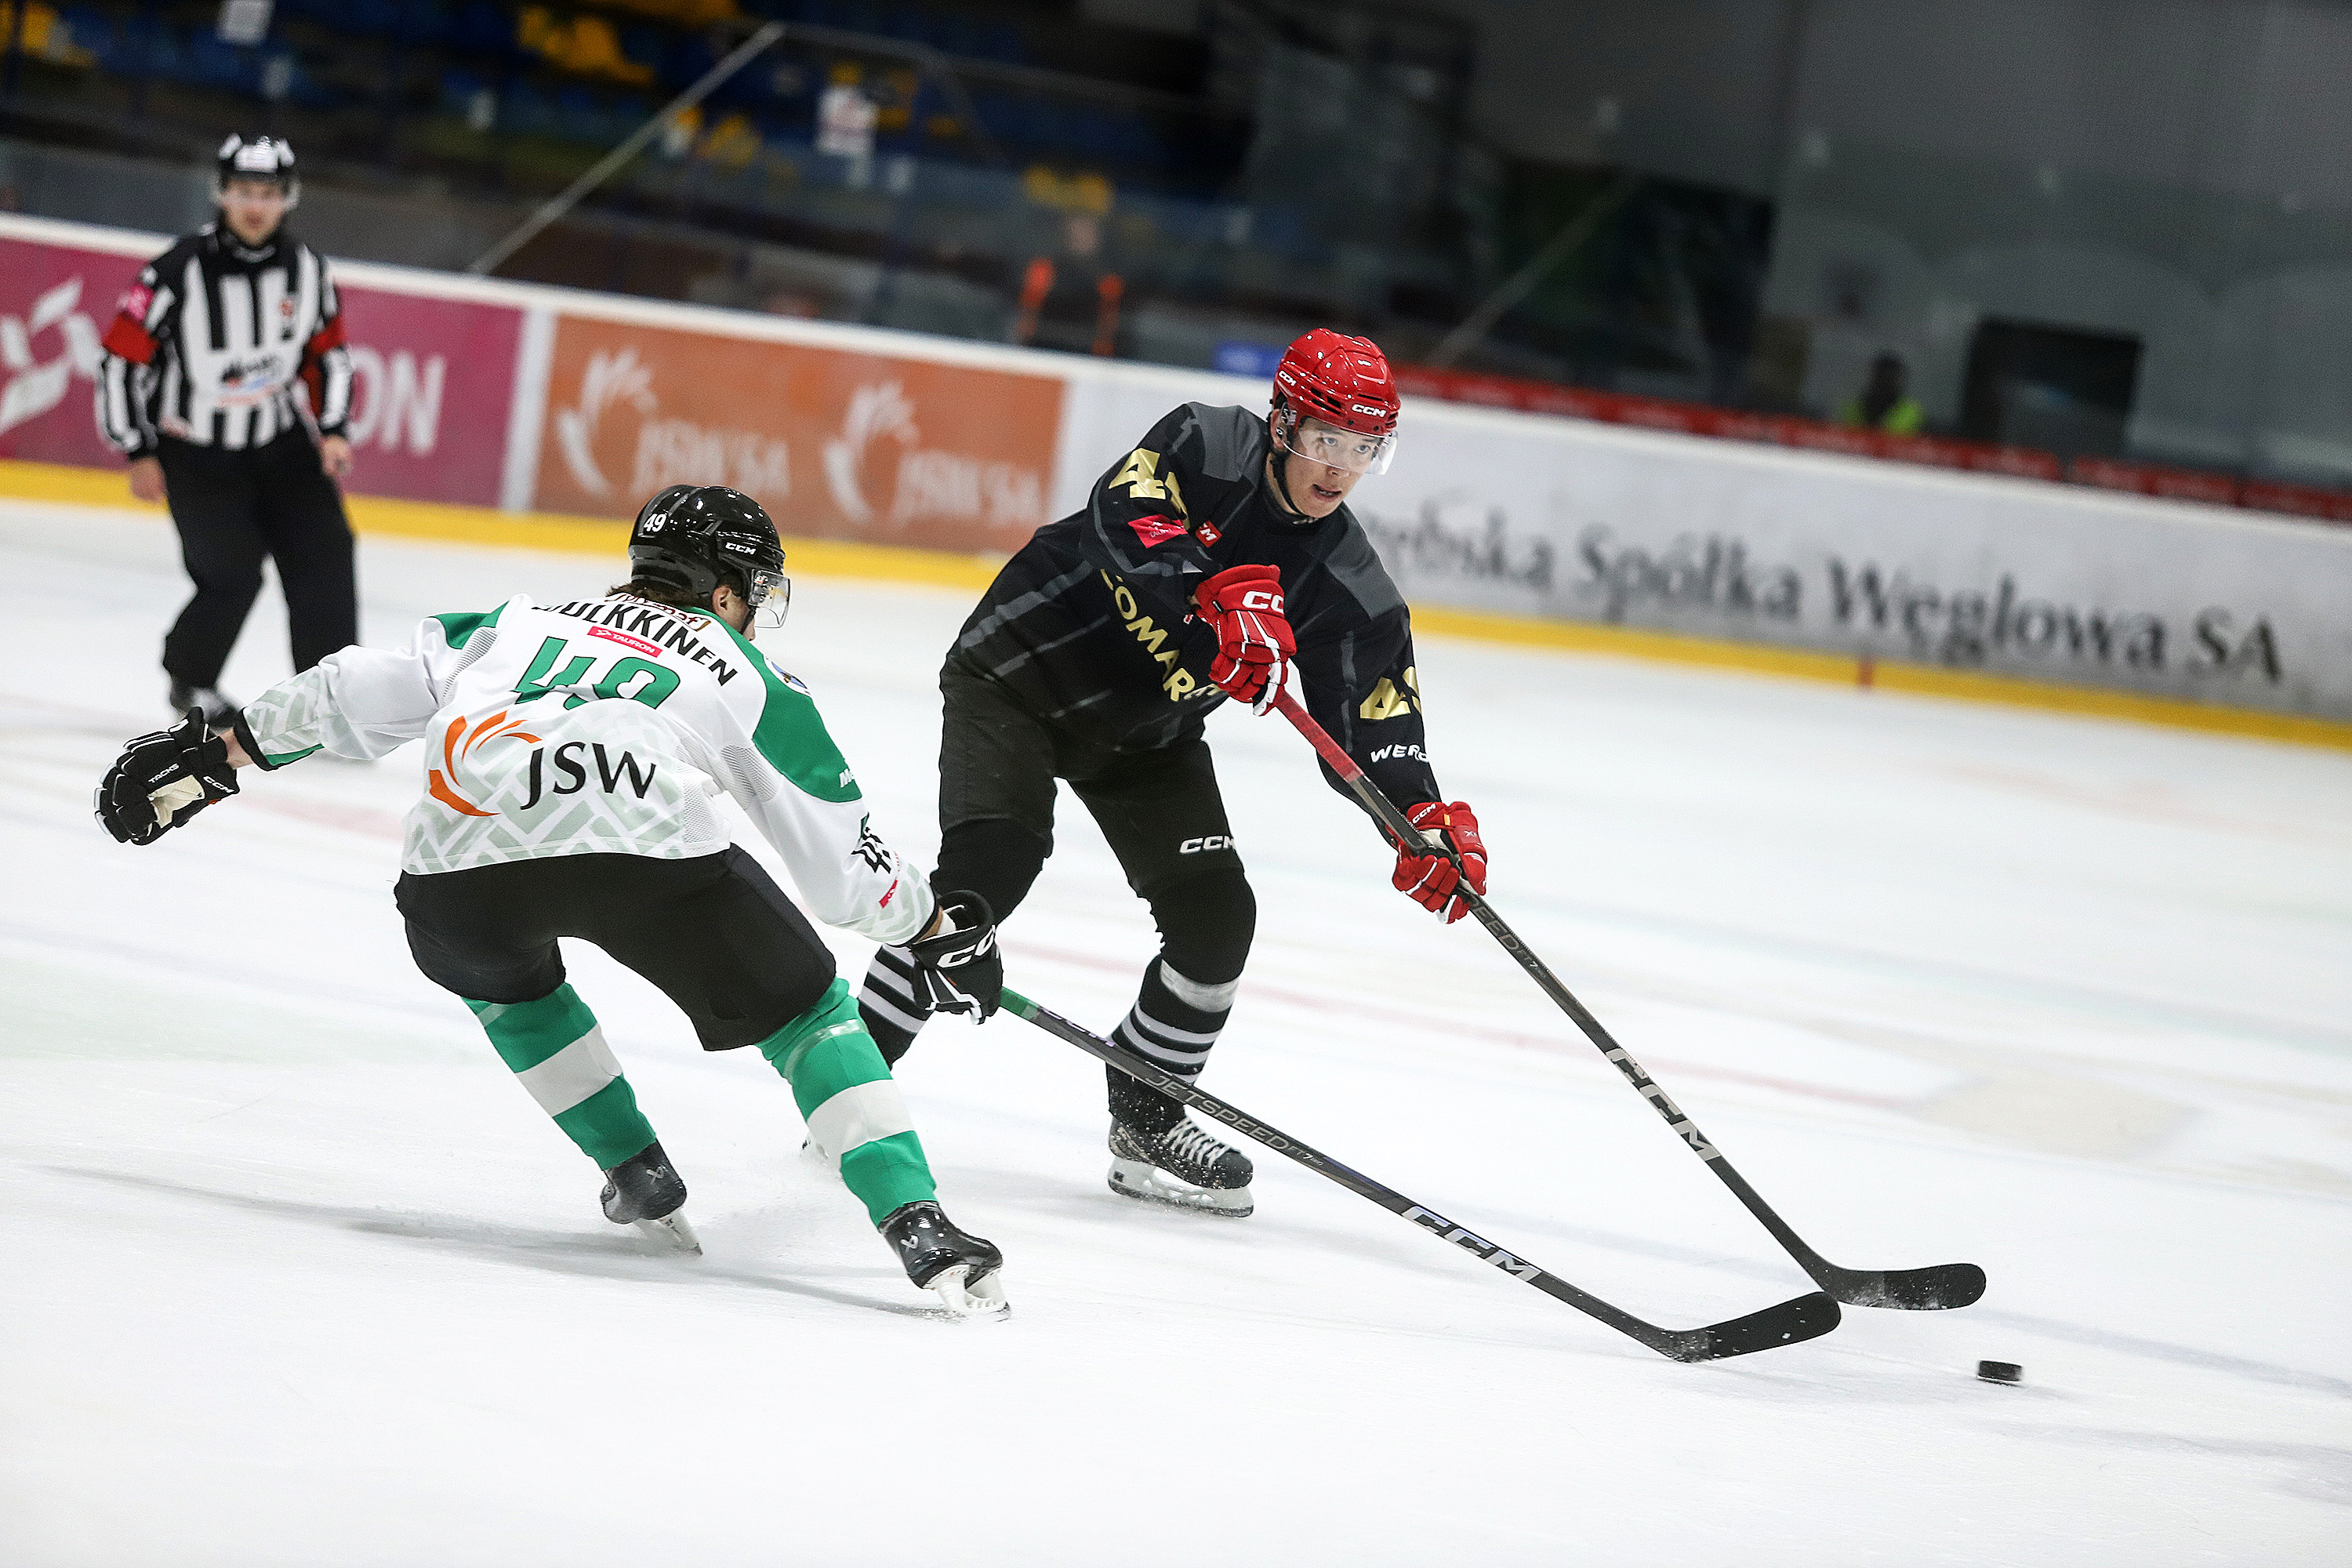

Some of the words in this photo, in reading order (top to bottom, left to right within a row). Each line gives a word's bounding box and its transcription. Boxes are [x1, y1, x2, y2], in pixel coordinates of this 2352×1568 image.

[1279, 370, 1297, 387] CCM
[1352, 404, 1387, 418] CCM
[644, 514, 666, 532] 49
[725, 542, 757, 555] CCM
[612, 632, 655, 653] TAURON
[2186, 604, 2285, 687] SA
[148, 763, 180, 782] TACKS
[520, 741, 657, 811] JSW
[203, 775, 234, 793] CCM
[1412, 803, 1436, 824] CCM
[1145, 1075, 1290, 1149] JETSPEED
[1606, 1047, 1722, 1161] CCM
[1402, 1205, 1542, 1282] CCM
